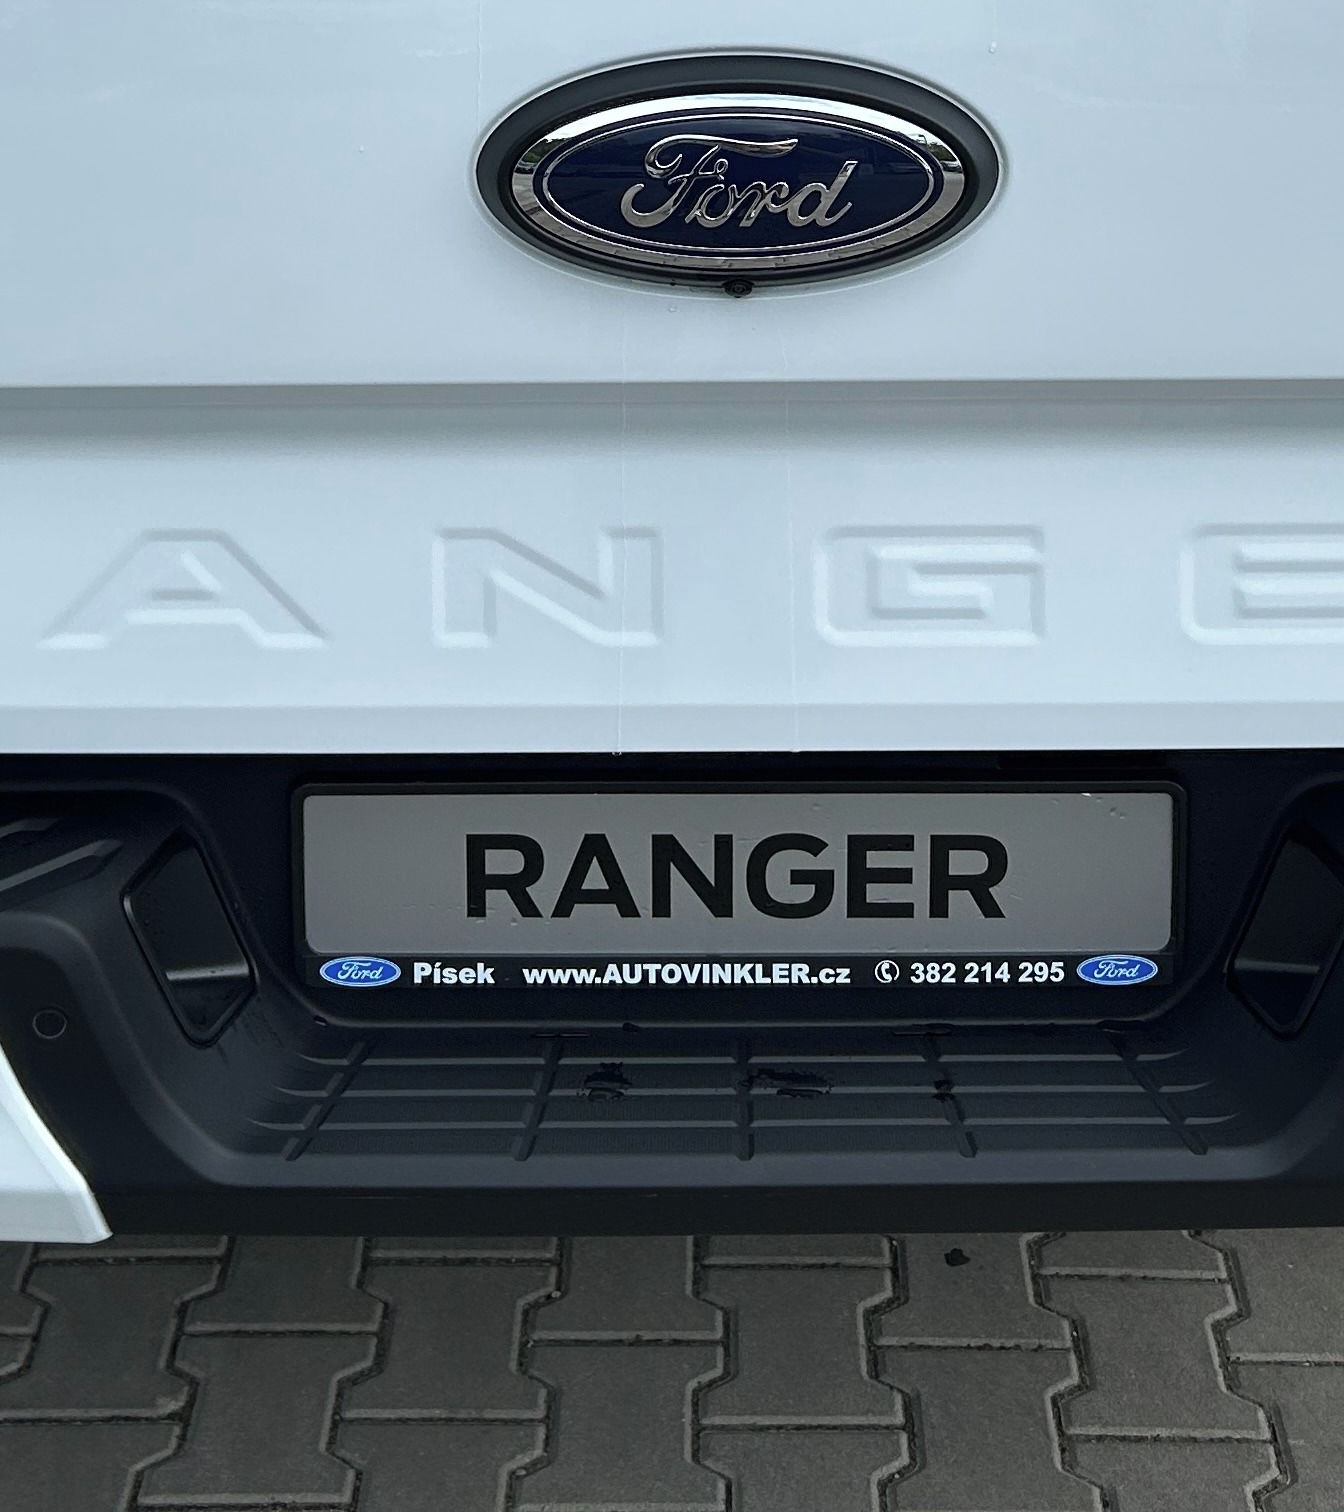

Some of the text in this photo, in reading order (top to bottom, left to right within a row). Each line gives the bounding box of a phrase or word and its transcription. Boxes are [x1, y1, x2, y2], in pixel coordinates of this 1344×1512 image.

[620, 134, 858, 228] Ford
[465, 833, 1008, 919] RANGER
[337, 961, 1140, 984] Ford Písek www.AUTOVINKLER.cz 382 214 295 Ford
